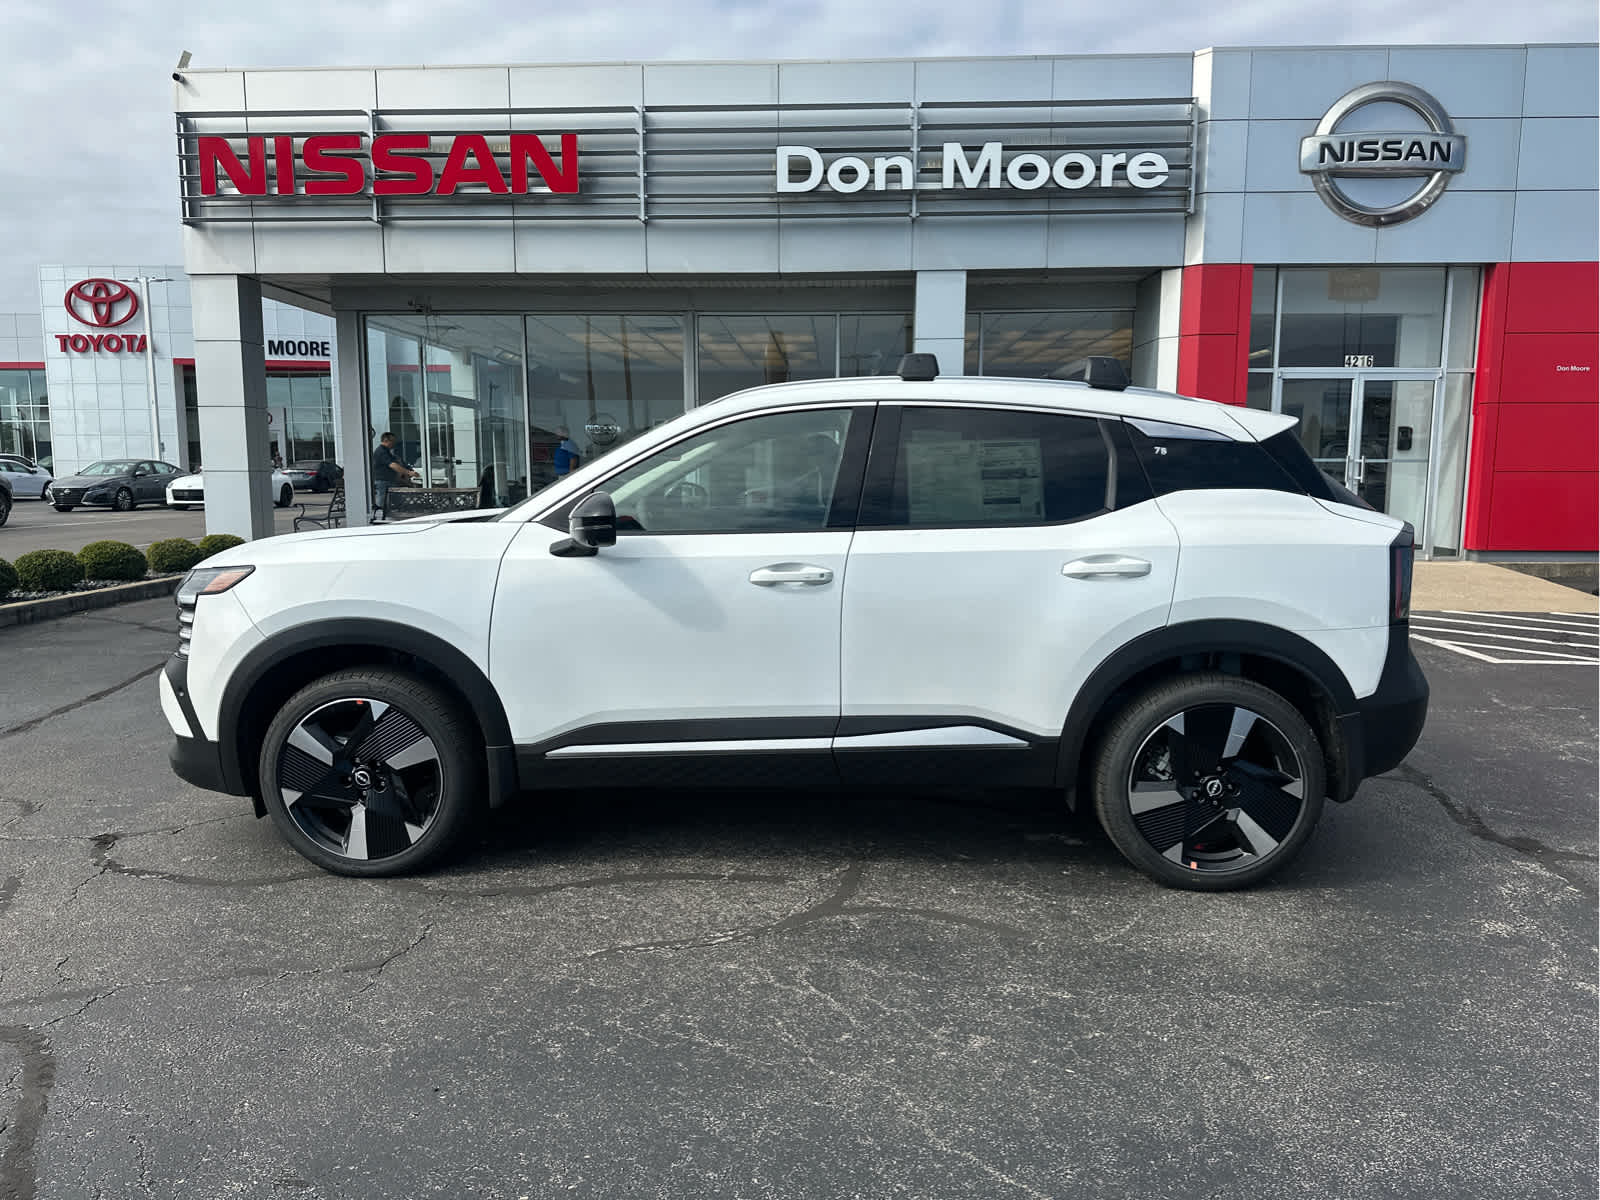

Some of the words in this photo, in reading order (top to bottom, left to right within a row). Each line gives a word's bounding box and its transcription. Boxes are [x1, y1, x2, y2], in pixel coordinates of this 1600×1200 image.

[1319, 140, 1452, 164] NISSAN
[198, 133, 579, 195] NISSAN
[776, 145, 914, 193] Don
[941, 142, 1169, 190] Moore
[55, 334, 148, 353] TOYOTA
[268, 340, 331, 357] MOORE
[1345, 356, 1372, 368] 4216
